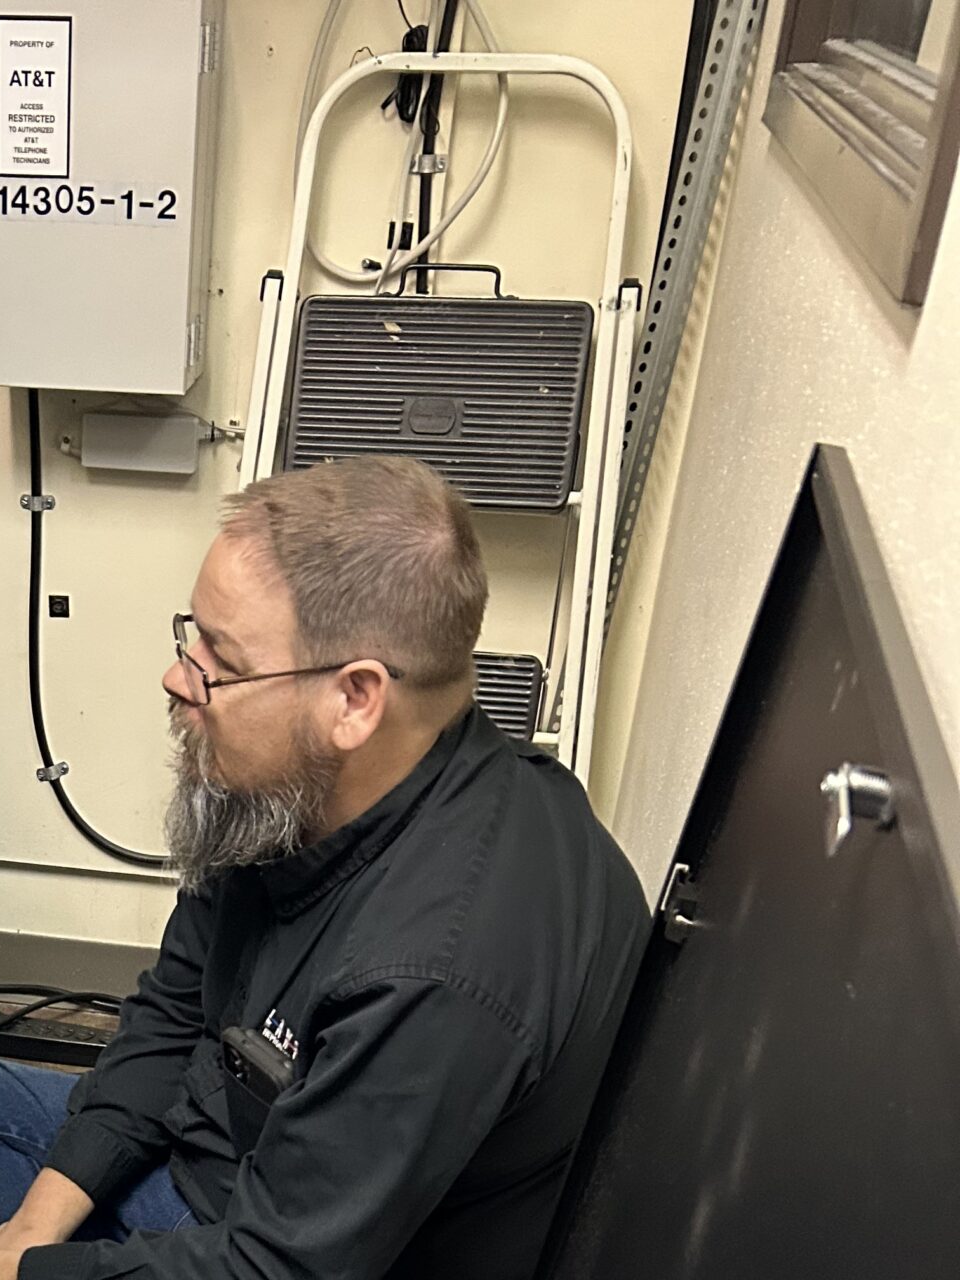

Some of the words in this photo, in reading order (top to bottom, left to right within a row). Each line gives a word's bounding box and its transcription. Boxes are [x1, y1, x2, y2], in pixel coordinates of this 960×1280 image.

[9, 40, 44, 48] PROPERTY
[45, 40, 55, 48] OF
[9, 69, 56, 88] AT&T
[8, 114, 56, 123] RESTRICTED
[8, 125, 17, 133] TO
[18, 126, 54, 134] AUTHORIZED
[23, 136, 39, 144] AT&T
[12, 157, 51, 165] TECHNICIANS
